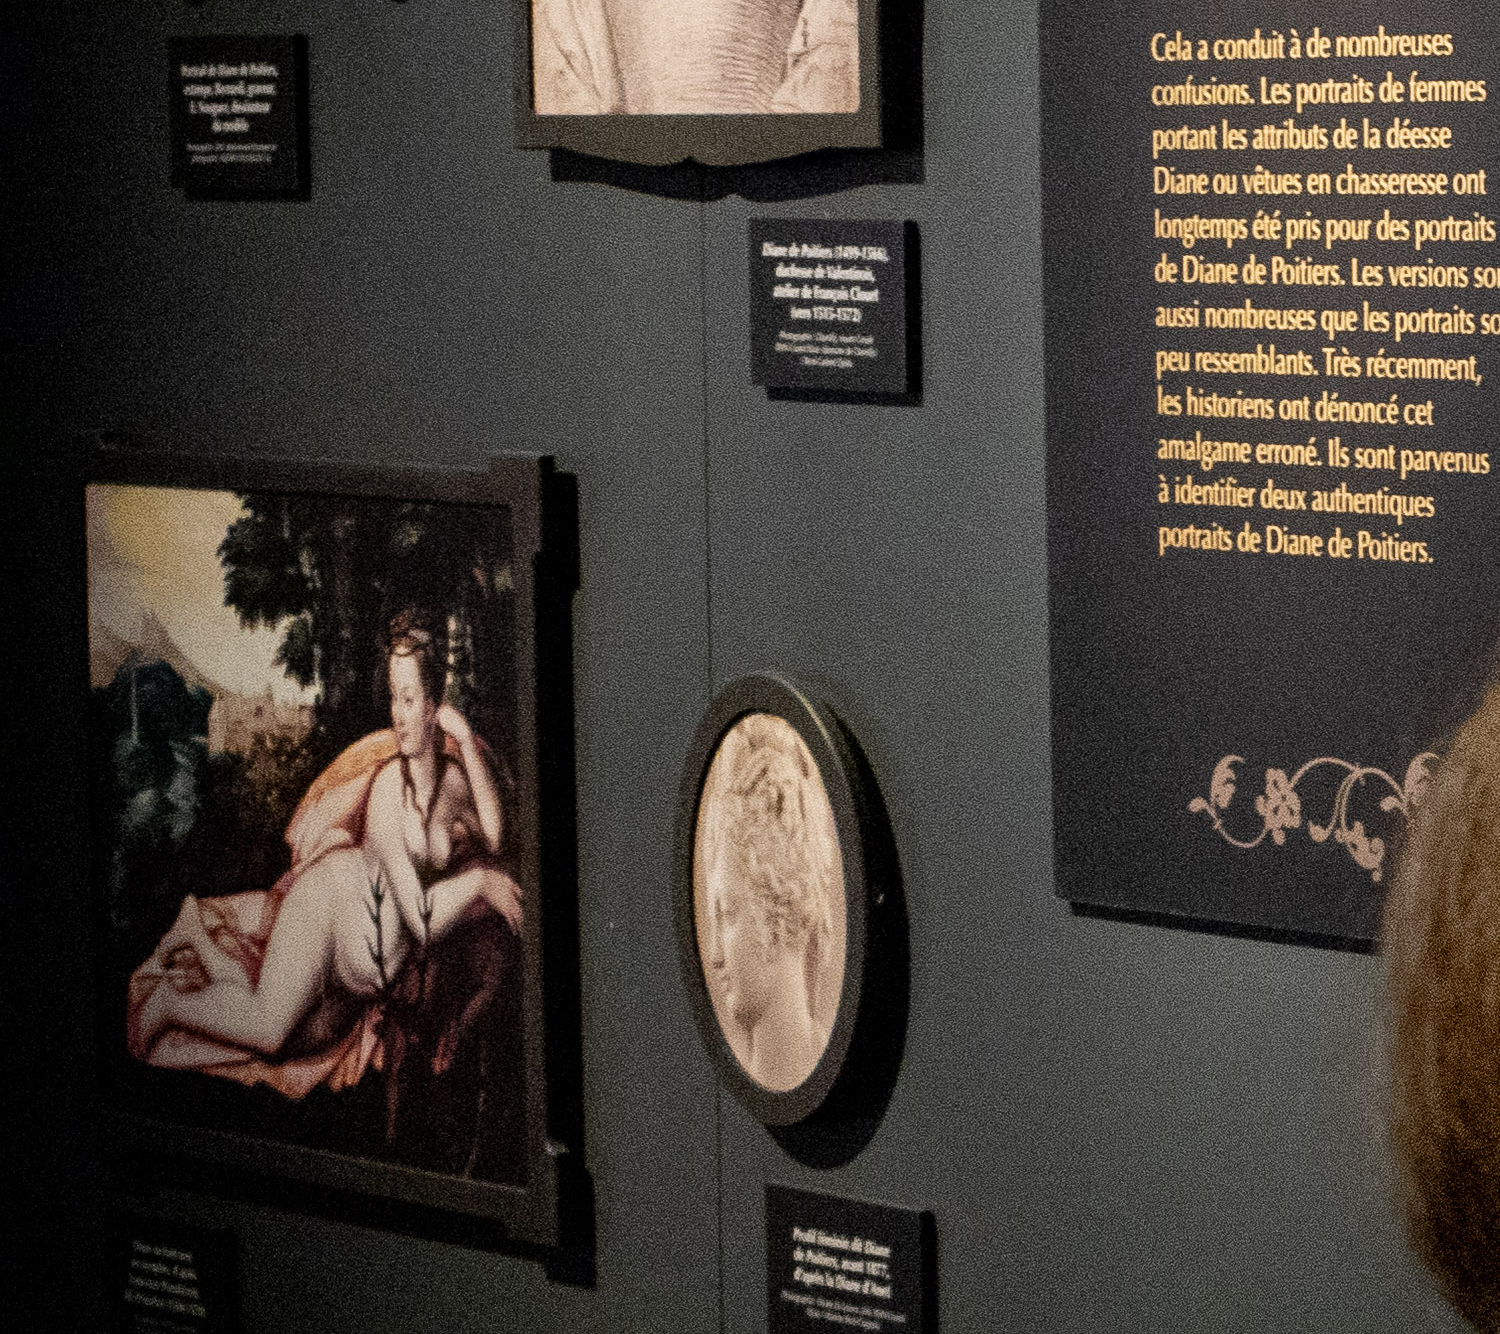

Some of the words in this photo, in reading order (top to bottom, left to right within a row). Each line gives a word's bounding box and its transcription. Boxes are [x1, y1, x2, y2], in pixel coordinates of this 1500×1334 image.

[1151, 32, 1192, 61] Cela
[1198, 40, 1208, 60] a
[1214, 29, 1284, 60] conduit
[1290, 29, 1301, 58] à
[1306, 28, 1331, 58] de
[1336, 26, 1453, 57] nombreuses
[1152, 76, 1254, 105] confusions.
[1261, 77, 1291, 104] Les
[1296, 75, 1374, 113] portraits
[1379, 72, 1404, 102] de
[1409, 71, 1486, 102] femmes
[1153, 126, 1217, 158] portant
[1223, 120, 1247, 149] les
[1253, 119, 1328, 149] attributs
[1333, 119, 1357, 149] de
[1364, 118, 1380, 149] la
[1386, 118, 1451, 148] déesse
[1154, 167, 1208, 194] Diane
[1213, 174, 1237, 194] ou
[1243, 165, 1302, 194] vêtues
[1307, 174, 1330, 194] en
[1336, 164, 1448, 194] chasseresse
[1453, 170, 1486, 194] ont
[1155, 210, 1248, 248] longtemps
[1253, 211, 1281, 239] été
[1286, 212, 1321, 248] pris
[1326, 220, 1371, 249] pour
[1376, 210, 1410, 240] des
[1415, 216, 1496, 250] portraits
